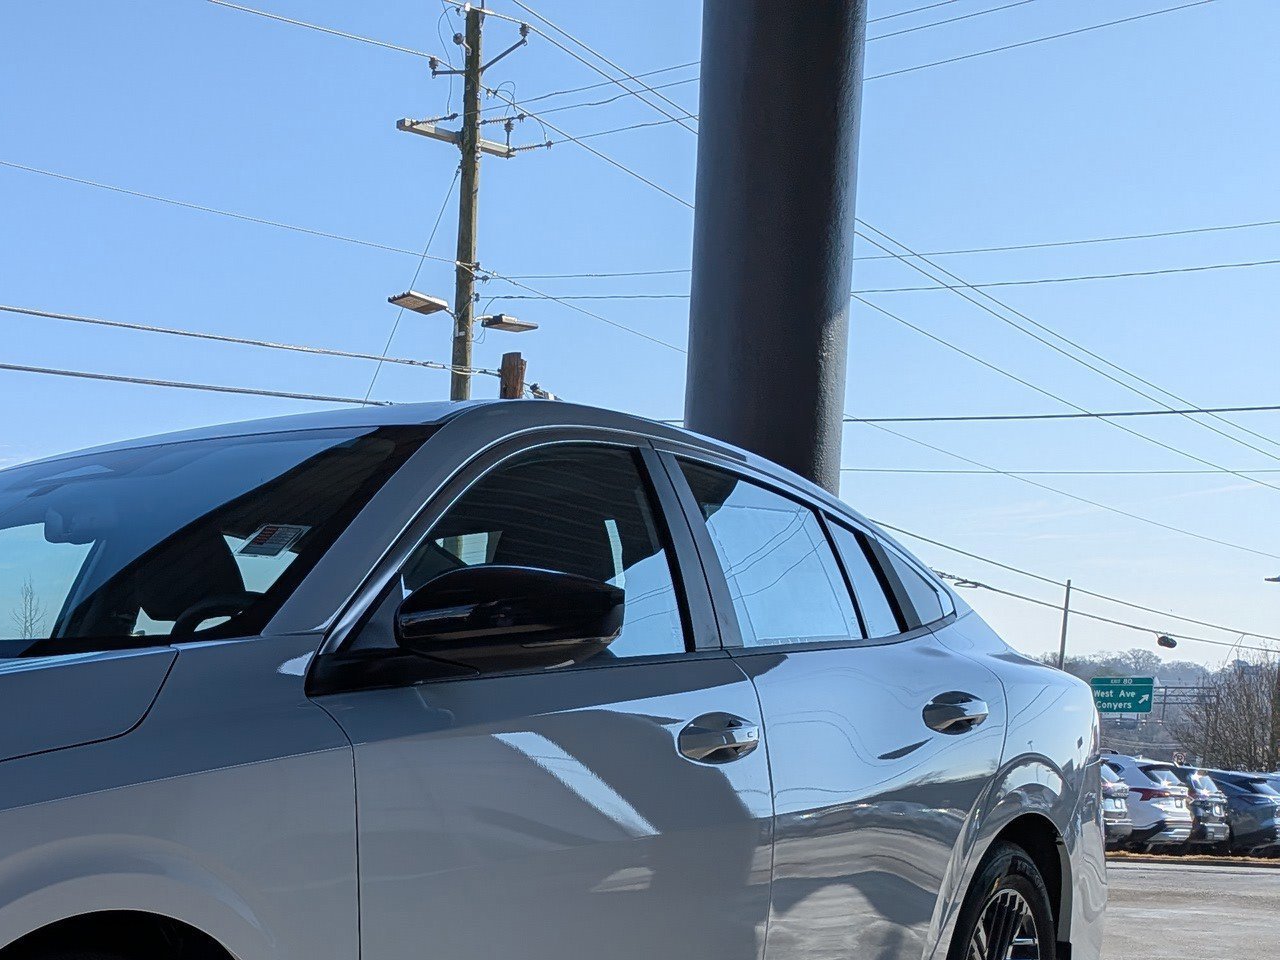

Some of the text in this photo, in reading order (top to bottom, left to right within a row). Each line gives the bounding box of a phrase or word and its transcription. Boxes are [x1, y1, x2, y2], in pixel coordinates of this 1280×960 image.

[1094, 690, 1136, 698] West Ave
[1095, 701, 1132, 710] Conyers
